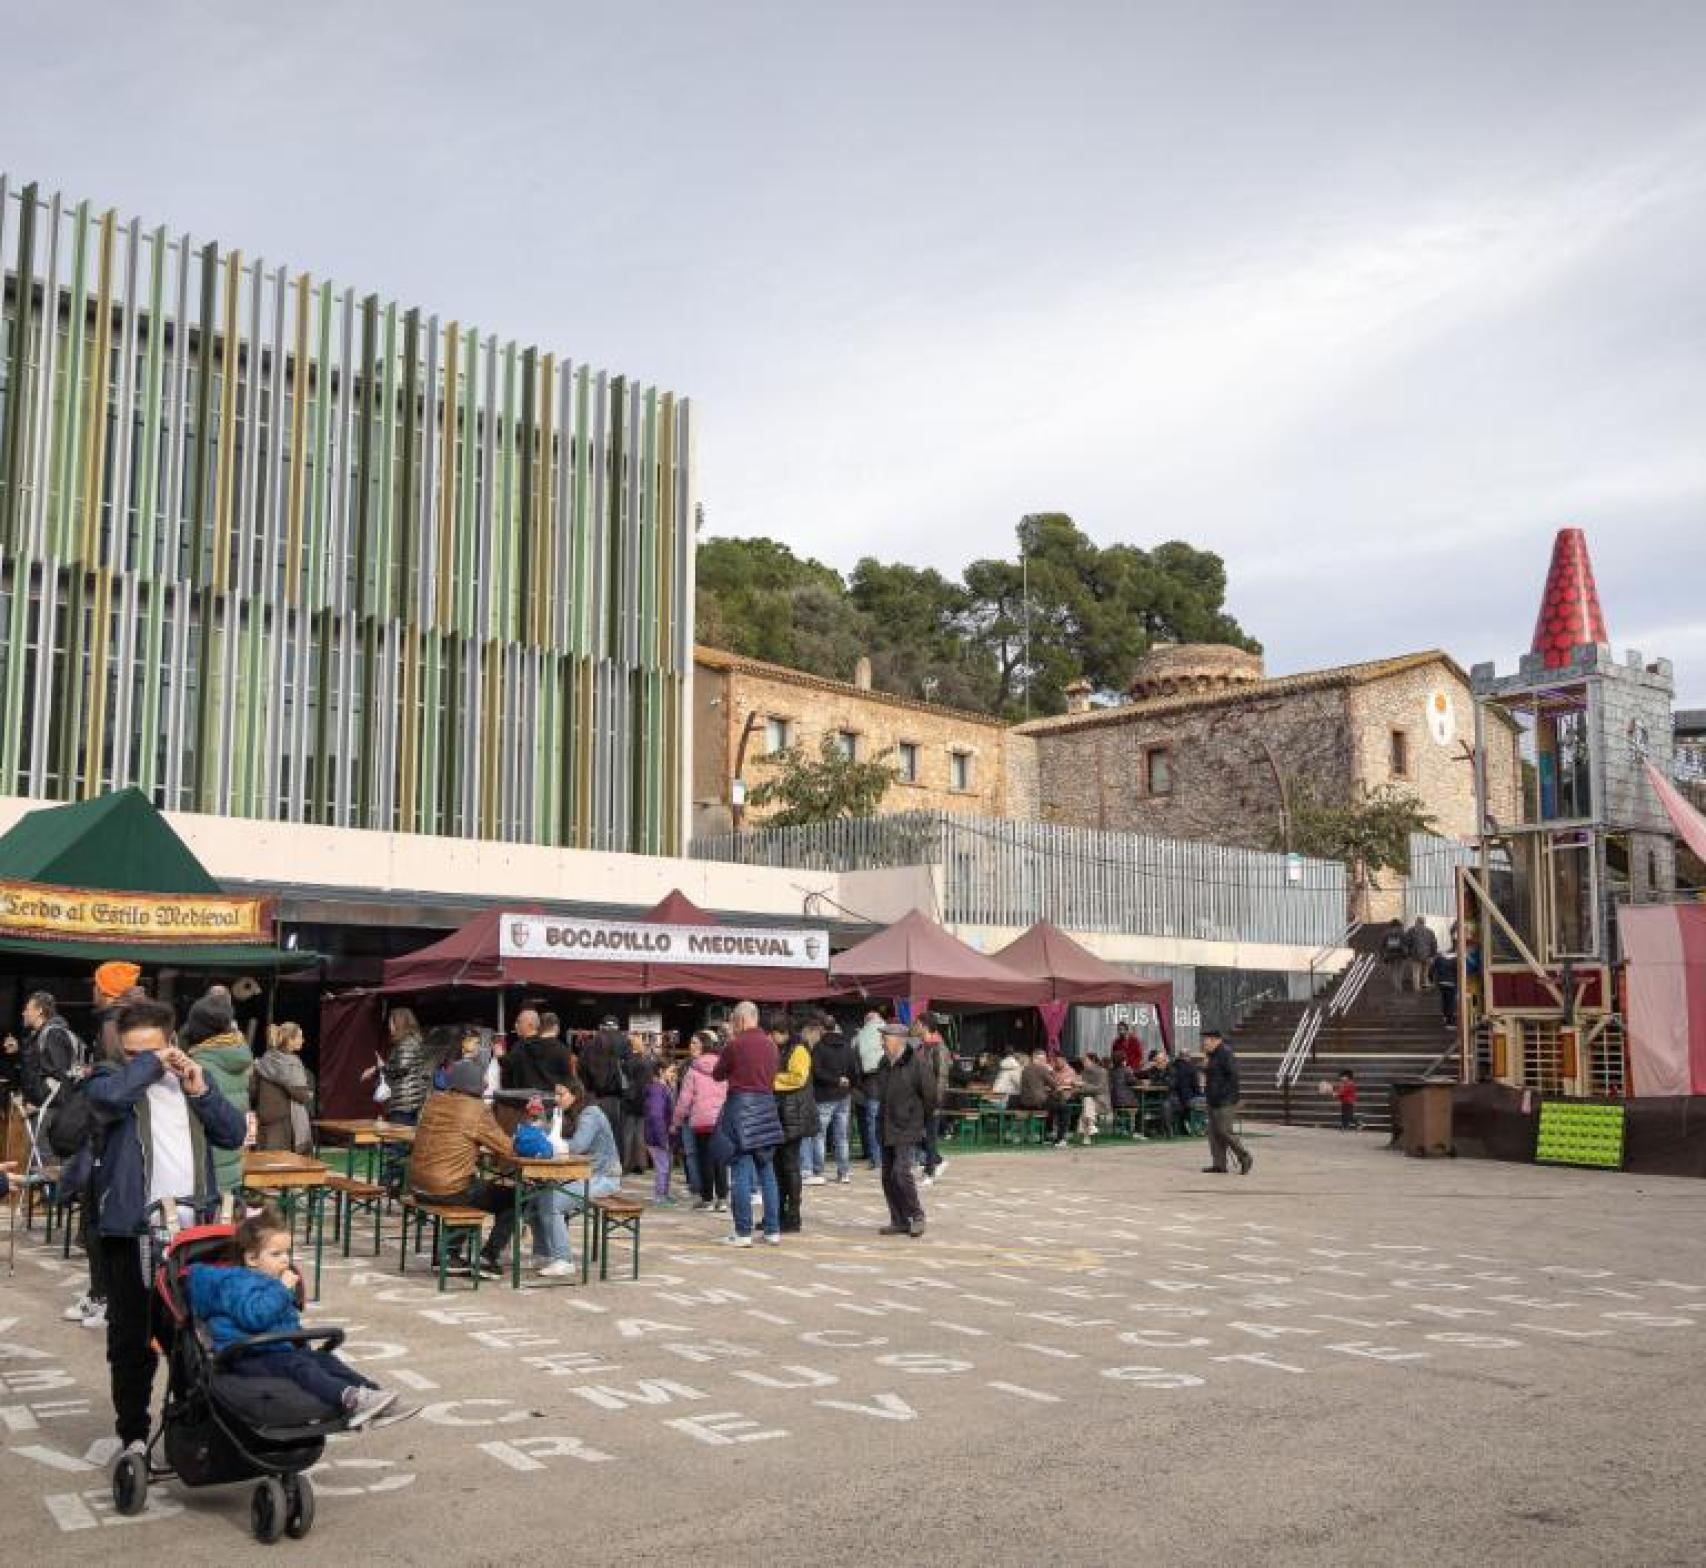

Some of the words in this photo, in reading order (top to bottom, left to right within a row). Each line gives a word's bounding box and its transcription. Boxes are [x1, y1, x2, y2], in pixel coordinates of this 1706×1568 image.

[66, 902, 86, 922] al
[91, 902, 150, 925] Estilo
[156, 905, 239, 927] Medieval
[545, 926, 671, 953] BOCADILLO
[689, 933, 795, 957] MEDIEVAL
